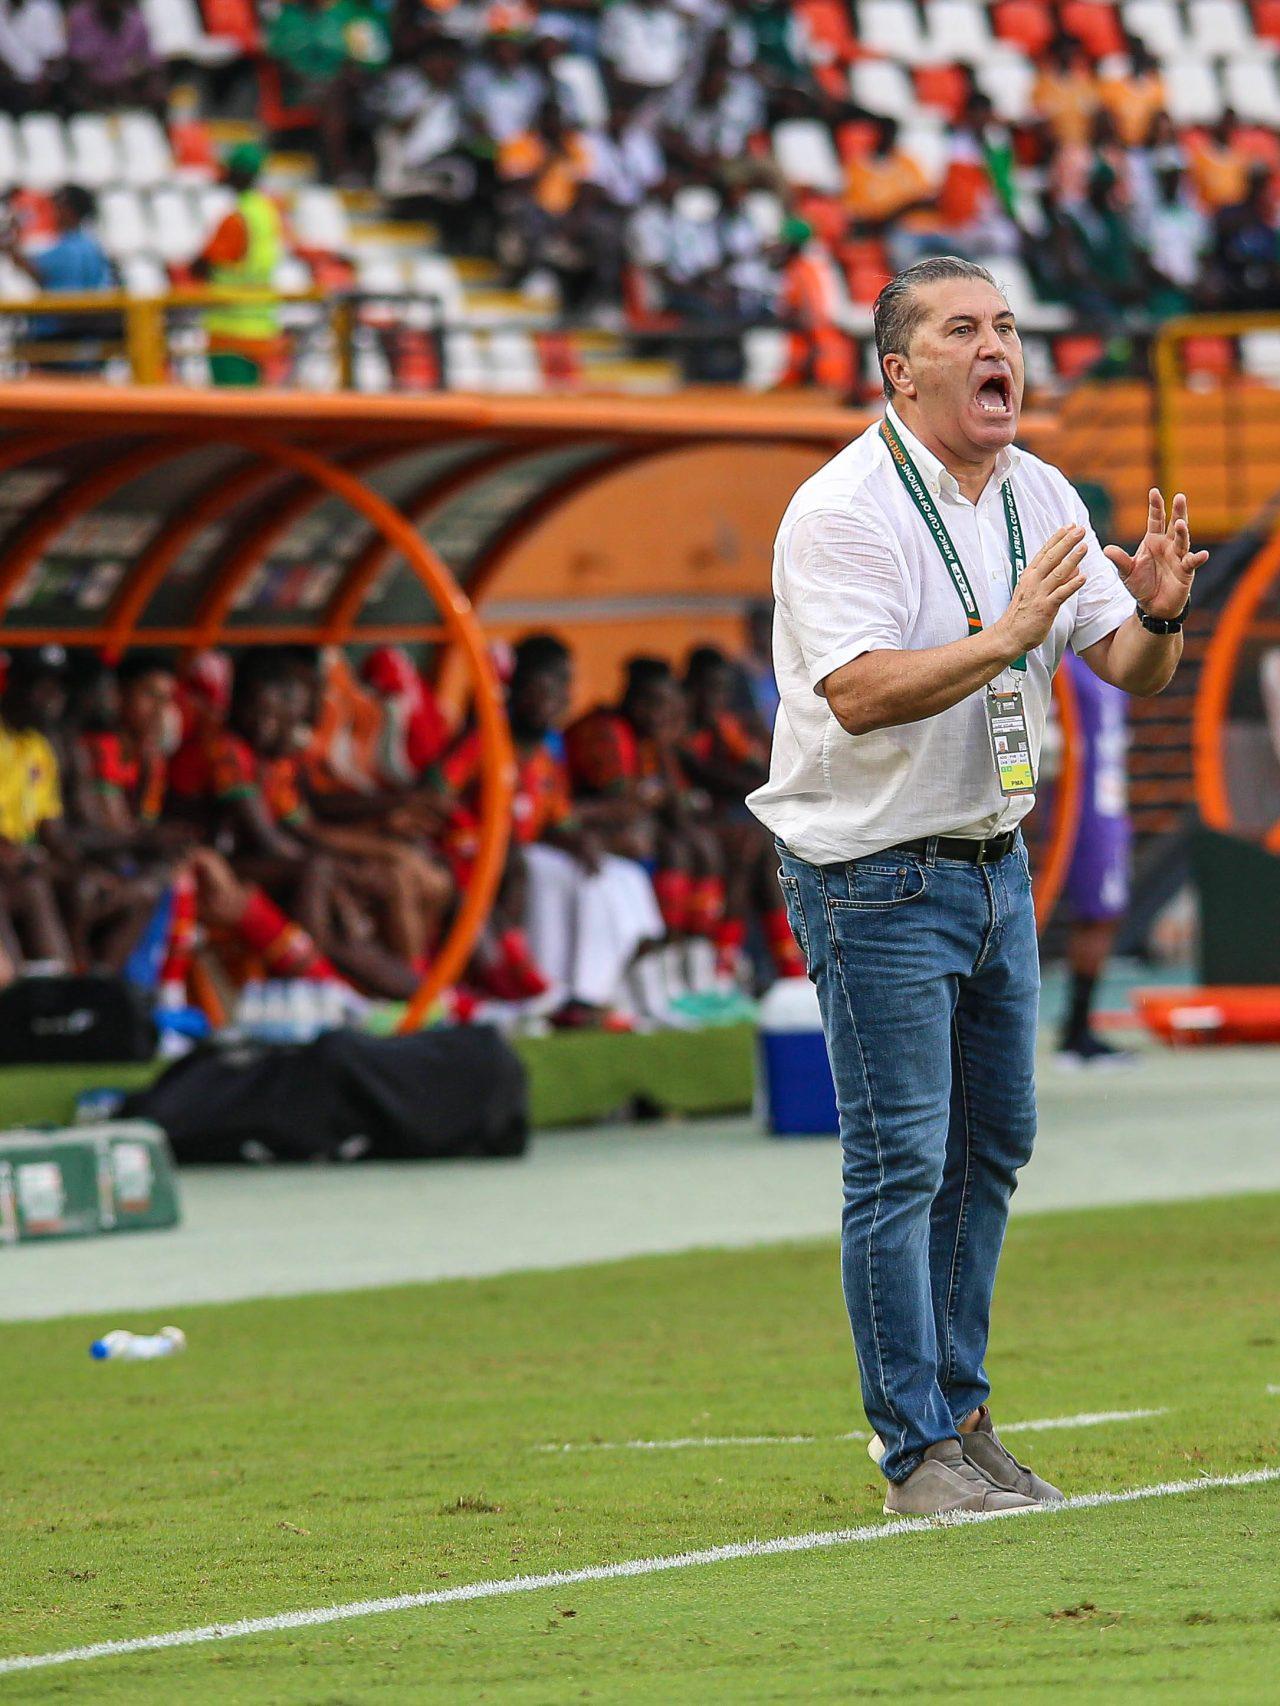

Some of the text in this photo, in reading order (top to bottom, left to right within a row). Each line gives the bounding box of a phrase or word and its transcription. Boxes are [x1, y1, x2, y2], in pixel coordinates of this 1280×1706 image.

[902, 464, 925, 500] NATIONS
[920, 498, 931, 512] OF
[1009, 507, 1018, 526] CUP
[927, 511, 940, 529] CUP
[936, 529, 955, 560] AFRICA
[1011, 528, 1022, 556] AFRICA
